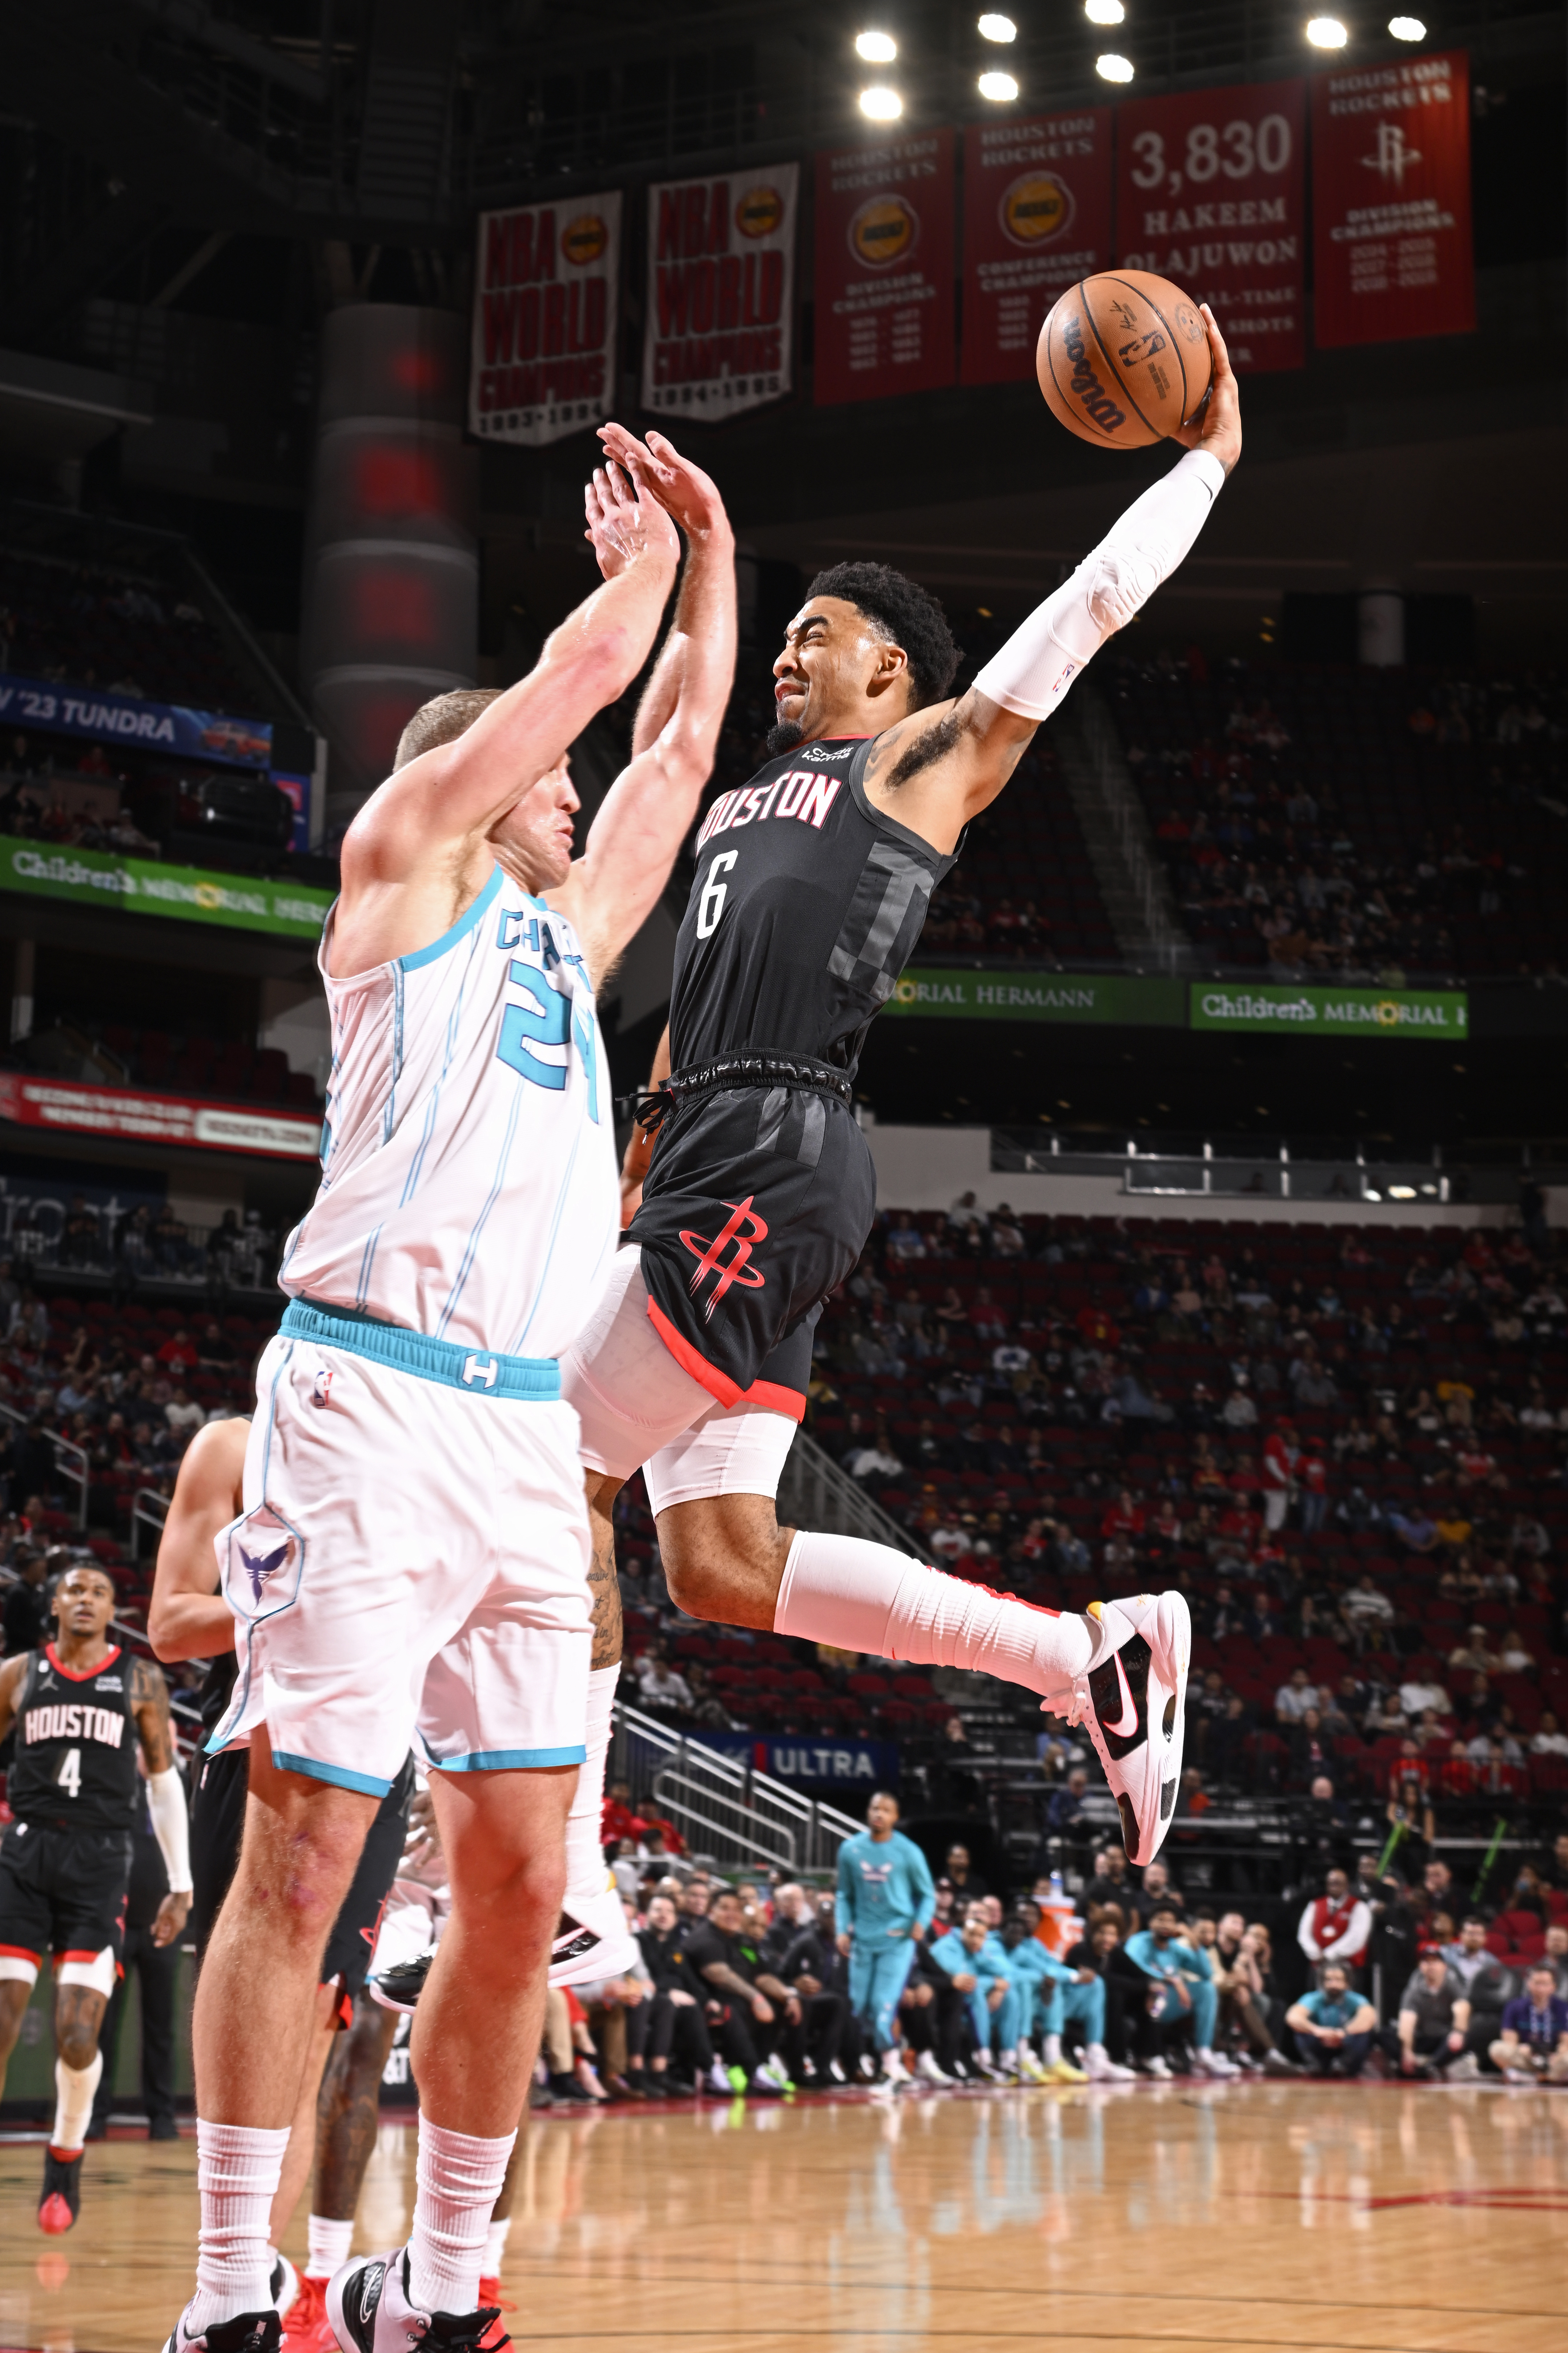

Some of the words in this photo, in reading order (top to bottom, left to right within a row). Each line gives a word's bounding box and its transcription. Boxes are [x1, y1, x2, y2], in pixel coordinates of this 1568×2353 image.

[1328, 60, 1451, 95] HOUSTON
[1329, 83, 1452, 115] ROCKETS
[981, 116, 1095, 146] HOUSTON
[831, 137, 938, 172] HOUSTON
[982, 137, 1094, 168] ROCKETS
[1130, 114, 1291, 196] 3,830
[832, 160, 937, 192] ROCKETS
[658, 181, 729, 260] NBA
[1144, 197, 1287, 236] HAKEEM
[1329, 211, 1456, 242] CHAMPIONS
[1346, 199, 1439, 224] DIVISION
[486, 210, 555, 289] NBA
[977, 250, 1097, 277] CONFERENCE
[1123, 237, 1298, 277] OLAJUWON
[657, 250, 784, 338] WORLD
[833, 285, 936, 314] CHAMPIONS
[845, 272, 924, 297] DIVISION
[484, 277, 607, 366] WORLD
[654, 329, 782, 386] CHAMPIONS
[1062, 316, 1126, 433] Wilson
[478, 354, 606, 412] CHAMPIONS
[63, 699, 175, 742] TUNDRA
[13, 850, 138, 894] Children's
[697, 850, 738, 939] 6
[977, 985, 1095, 1007] HERMANN
[1202, 994, 1317, 1021] Children's
[1324, 1001, 1447, 1026] MEMORIAL
[586, 1571, 608, 1582] easure
[25, 1704, 125, 1748] HOUSTON
[58, 1748, 81, 1797] 4
[773, 1747, 875, 1780] ULTRA
